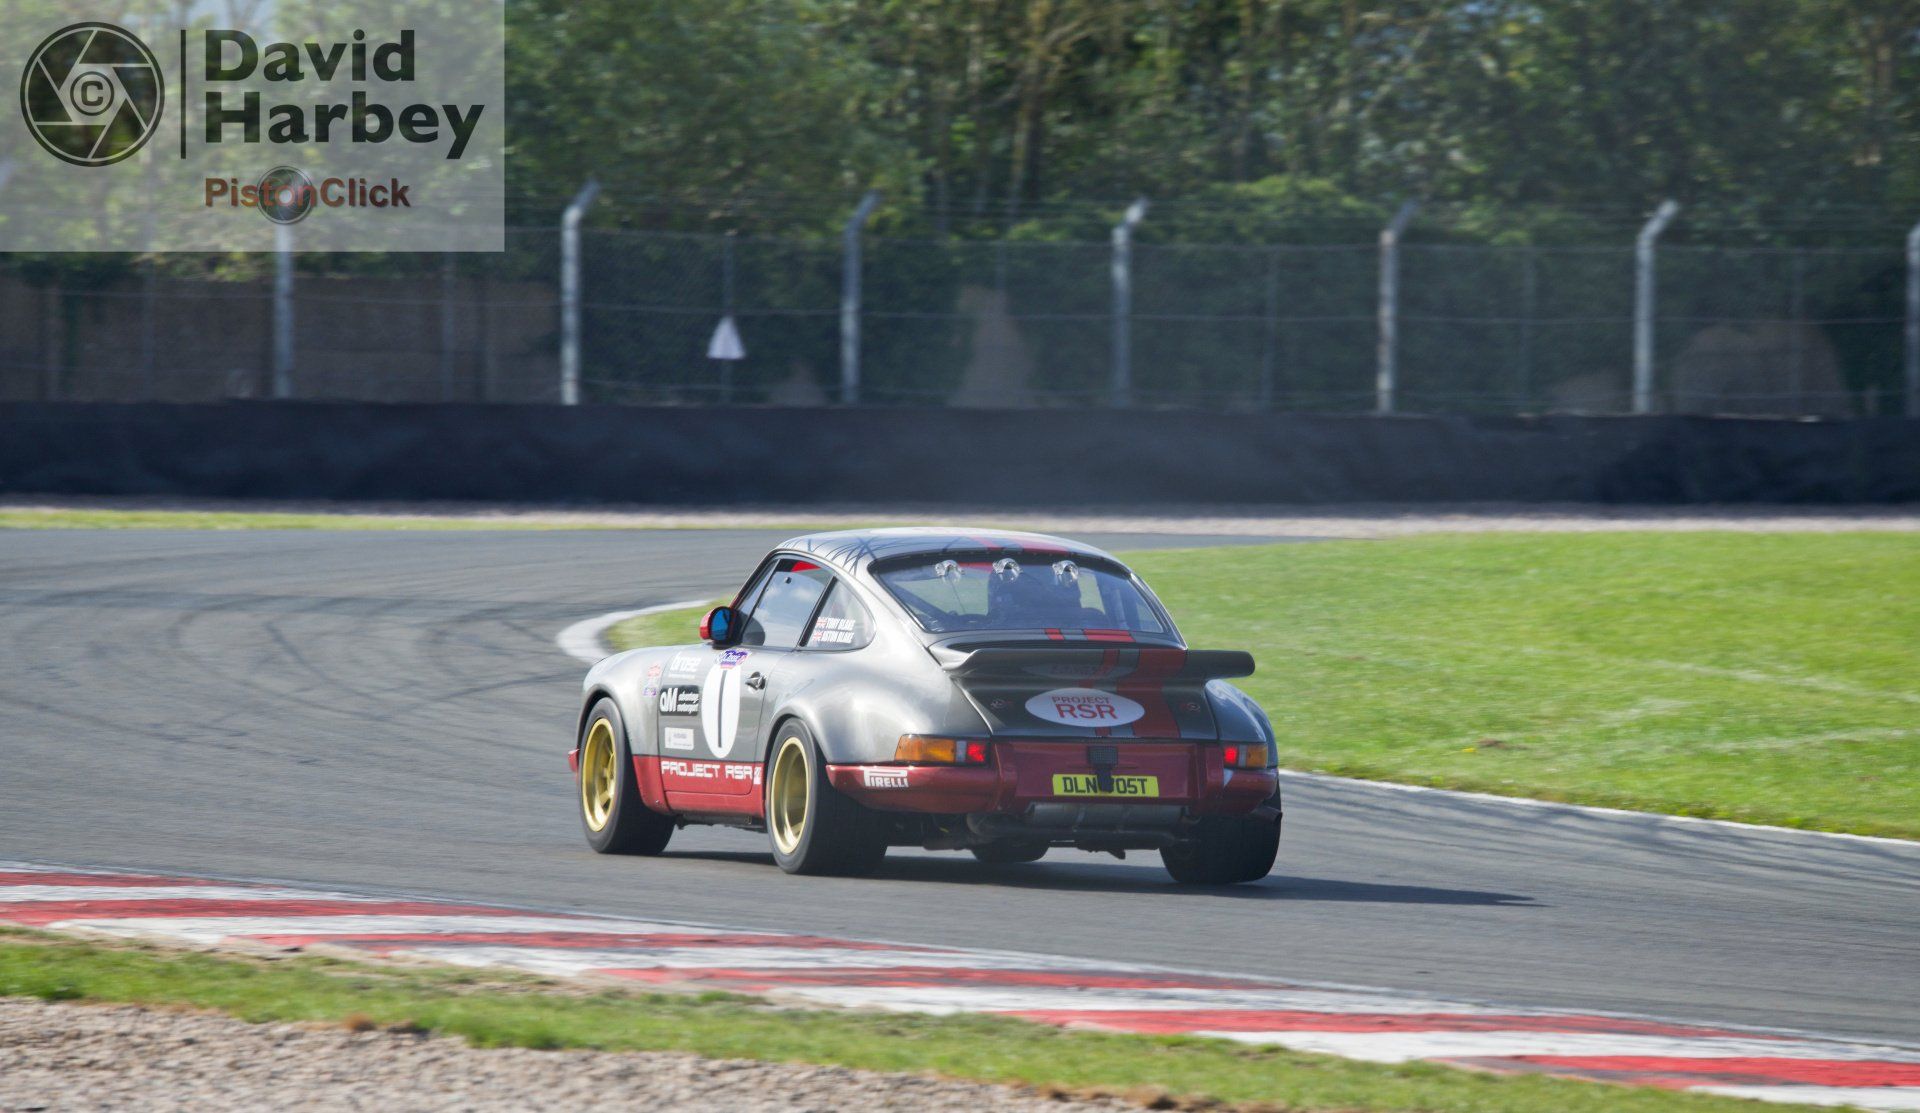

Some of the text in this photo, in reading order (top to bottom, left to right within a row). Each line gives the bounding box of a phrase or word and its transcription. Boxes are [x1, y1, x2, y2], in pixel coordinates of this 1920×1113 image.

[1051, 696, 1110, 704] PROJECT
[1055, 703, 1118, 719] RSR
[661, 760, 721, 779] PROJECT
[725, 765, 753, 780] RSR
[863, 769, 909, 787] PIRELLI
